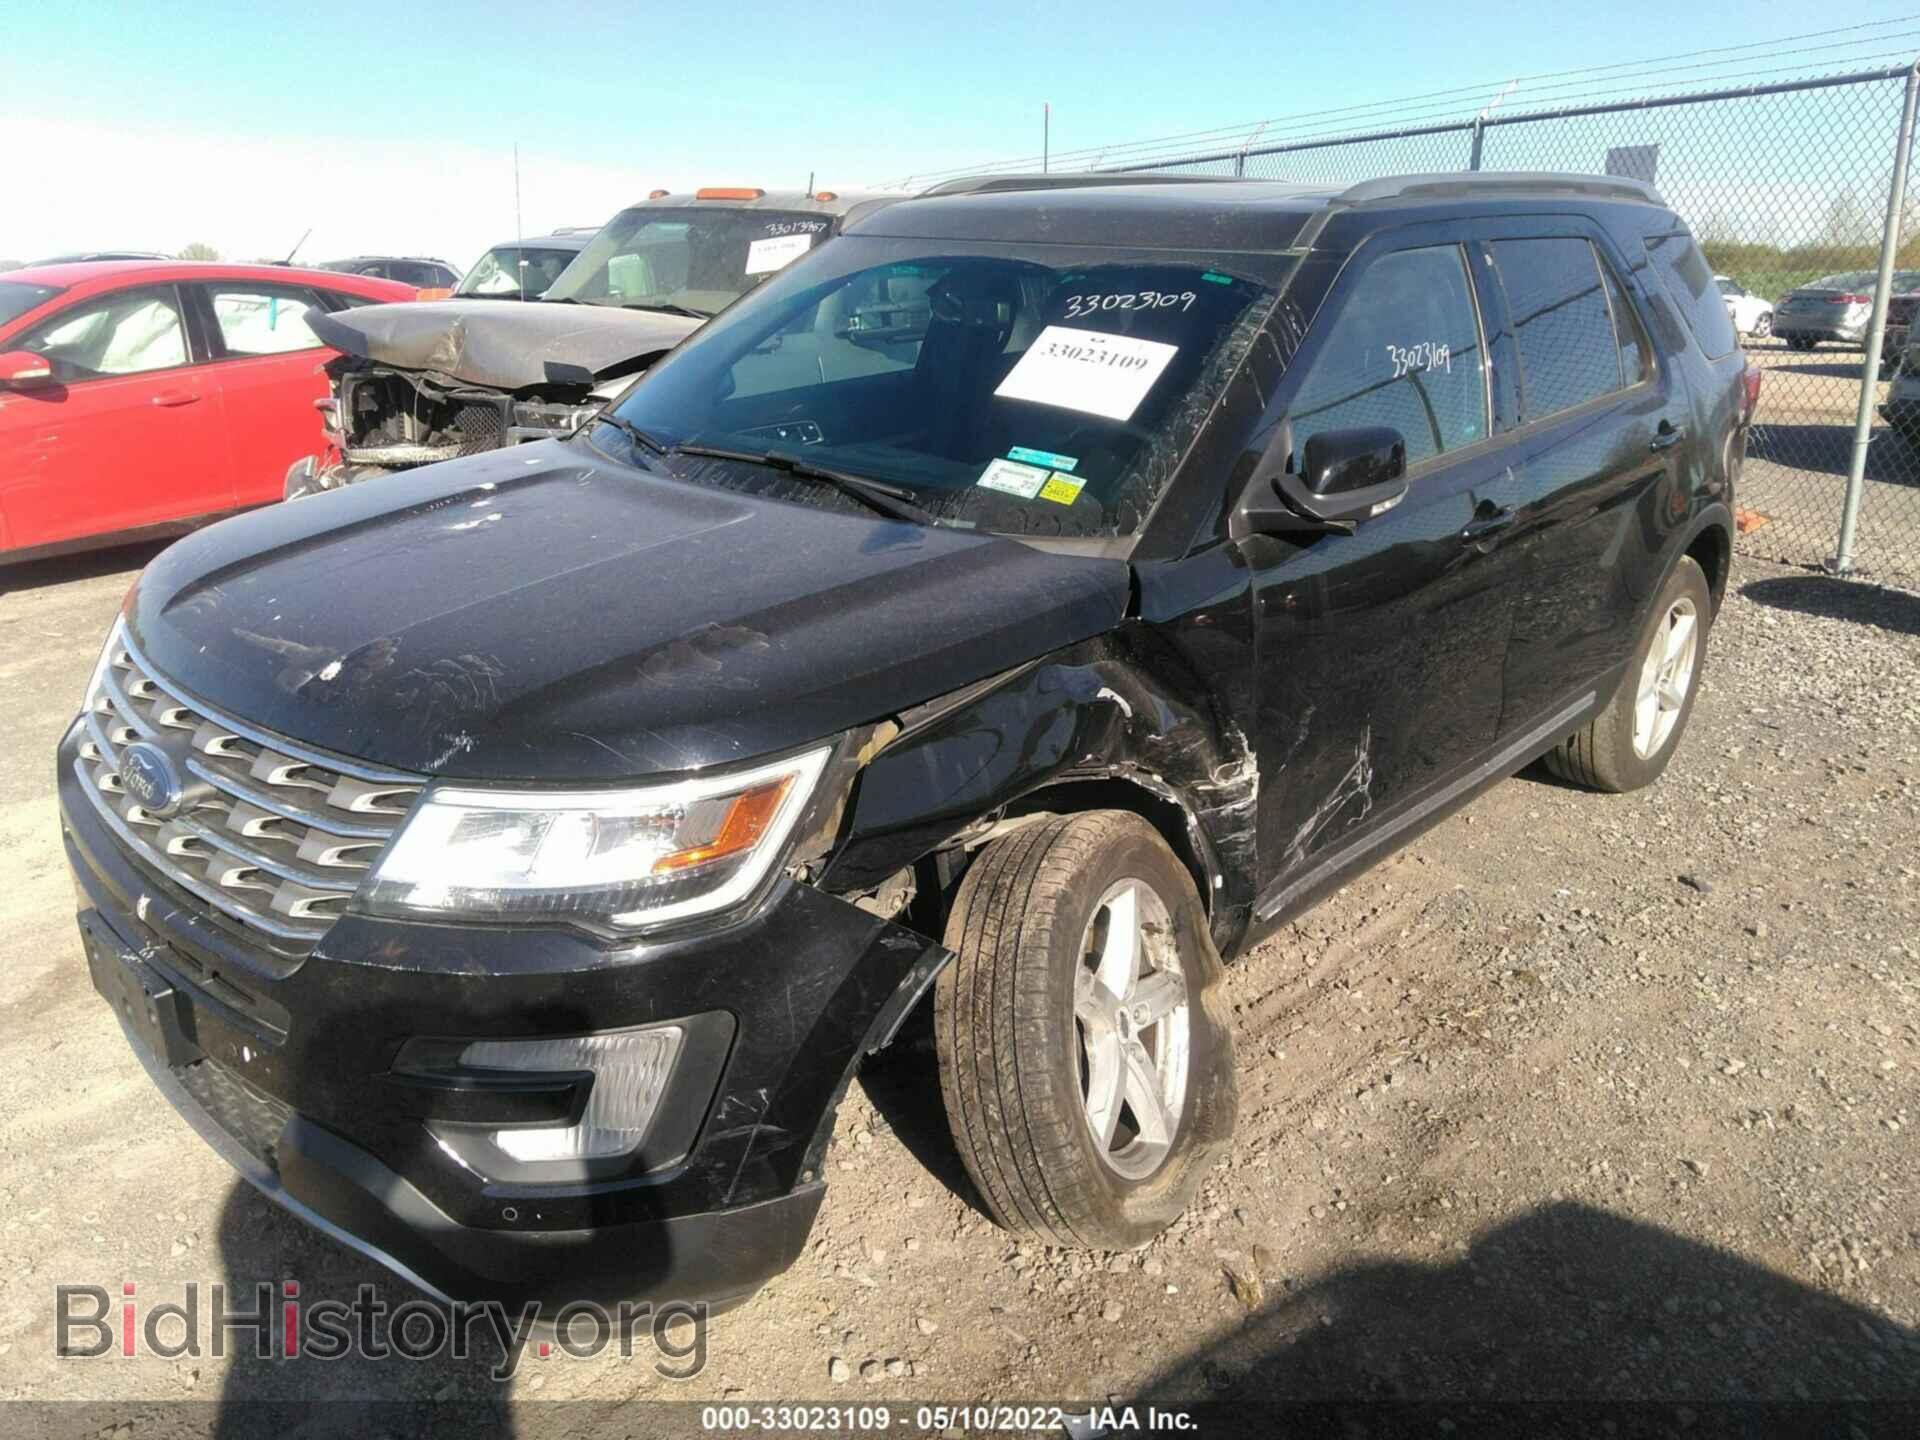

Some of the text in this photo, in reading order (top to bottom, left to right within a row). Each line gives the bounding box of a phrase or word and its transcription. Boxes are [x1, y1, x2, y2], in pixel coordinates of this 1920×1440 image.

[1064, 291, 1196, 319] 33023109
[1040, 342, 1149, 370] 33023109
[1386, 342, 1451, 378] 33023109
[122, 752, 154, 800] Ford
